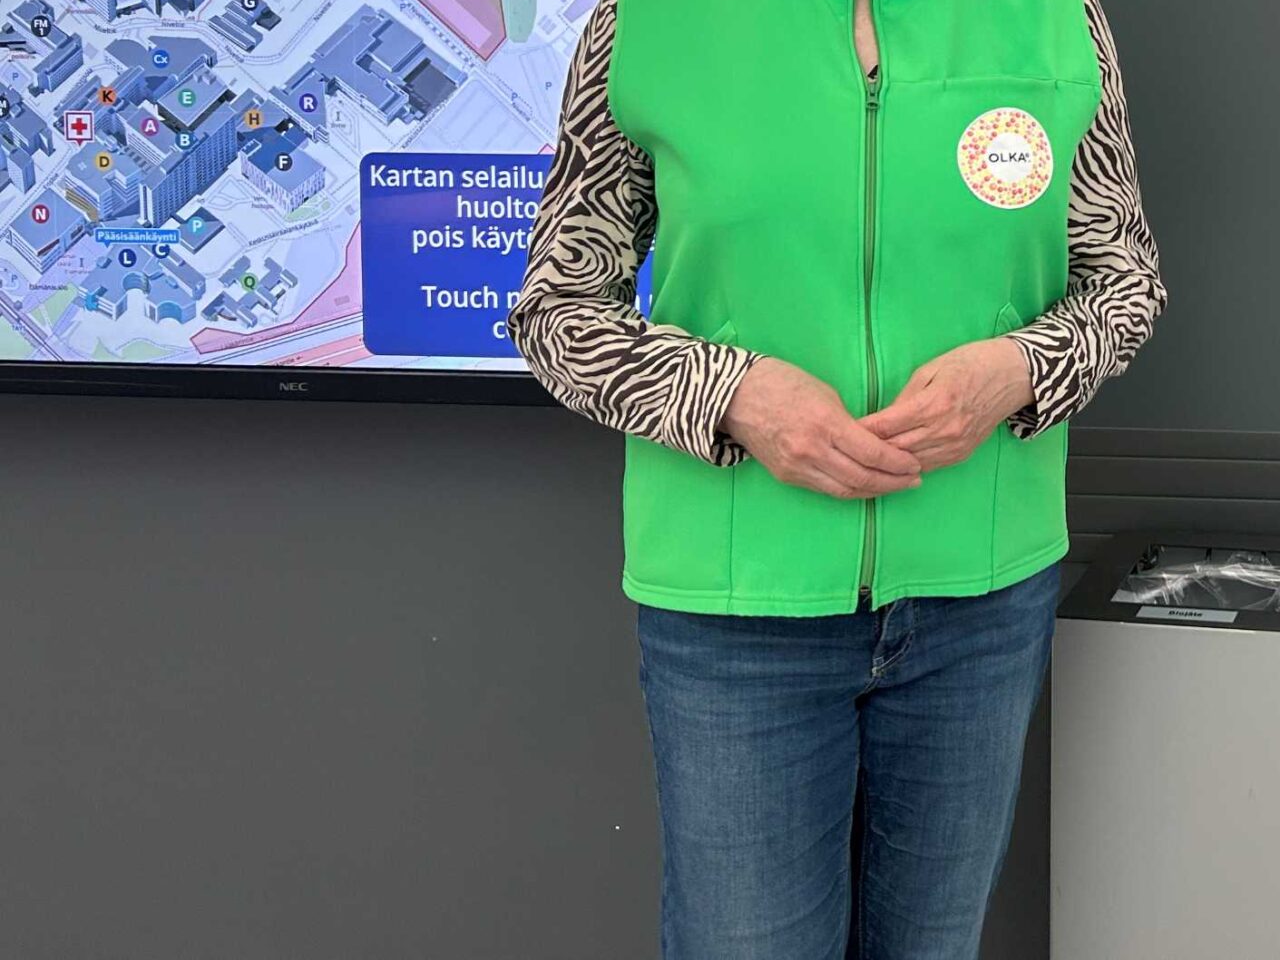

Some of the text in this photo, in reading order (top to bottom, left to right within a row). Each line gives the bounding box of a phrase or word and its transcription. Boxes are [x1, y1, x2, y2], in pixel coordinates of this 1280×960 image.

[33, 19, 48, 28] FM
[153, 52, 168, 64] Cx
[102, 90, 113, 102] K
[181, 92, 191, 104] E
[303, 96, 315, 109] R
[248, 113, 260, 125] H
[144, 120, 157, 133] A
[179, 134, 190, 147] B
[99, 156, 109, 168] D
[279, 155, 288, 169] F
[370, 164, 543, 189] Kartan selailu
[35, 208, 46, 220] N
[192, 221, 202, 233] P
[98, 231, 177, 243] Pääsisäänkäynti
[412, 226, 464, 253] pois
[156, 243, 167, 256] C
[124, 252, 132, 265] L
[244, 276, 256, 290] Q
[421, 284, 498, 309] Touch
[279, 382, 309, 391] NEC
